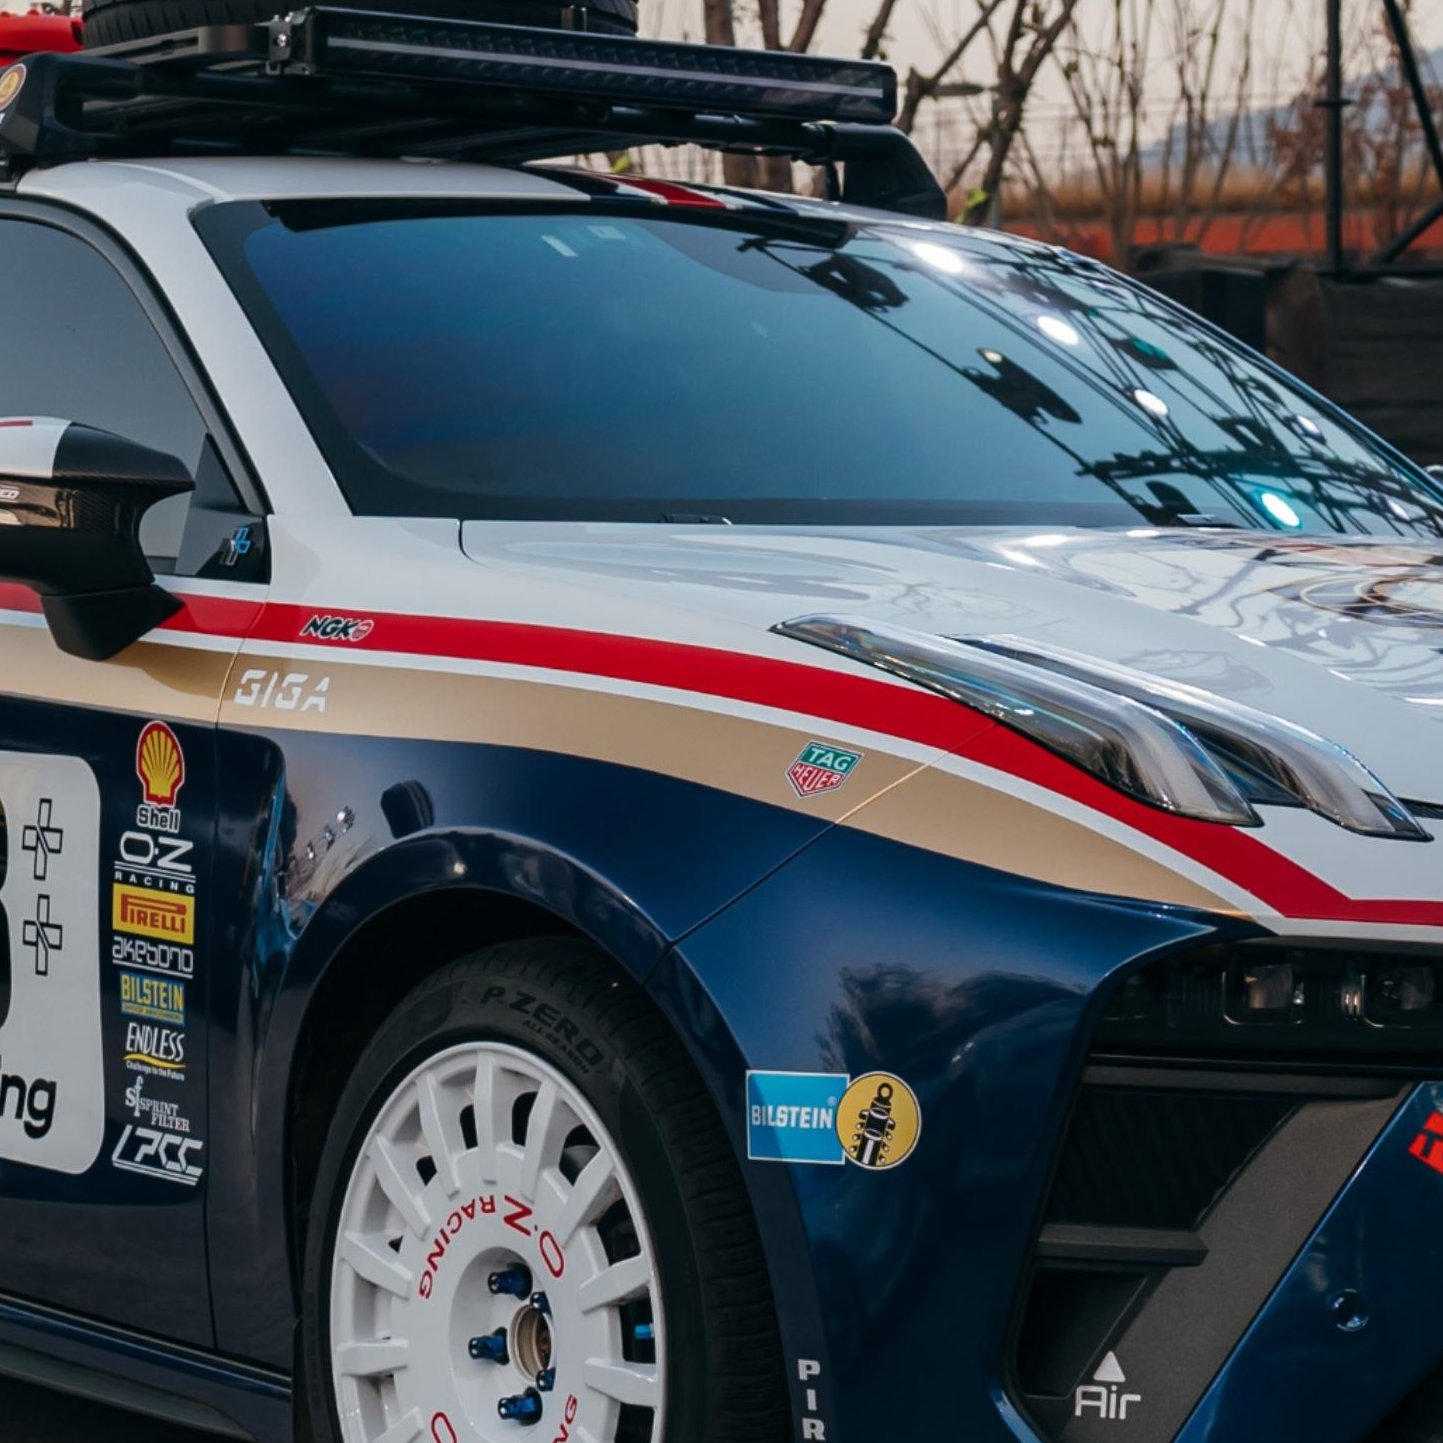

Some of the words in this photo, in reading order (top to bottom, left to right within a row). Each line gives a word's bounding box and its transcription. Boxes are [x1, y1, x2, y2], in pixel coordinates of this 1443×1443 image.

[300, 614, 360, 641] NGK
[810, 747, 852, 771] TAG
[793, 763, 840, 791] HEUER
[137, 804, 180, 833] Shell
[115, 871, 195, 894] RACING
[121, 893, 186, 934] PIRELLI
[121, 974, 184, 1011] BILSTEIN
[126, 1022, 185, 1061] ENDLESS
[508, 991, 605, 1066] ZERO
[140, 1097, 179, 1117] SPRINT
[751, 1105, 833, 1129] BILSTEIN
[151, 1113, 190, 1132] FILTER
[419, 1195, 495, 1299] RACING
[1075, 1386, 1141, 1420] Air
